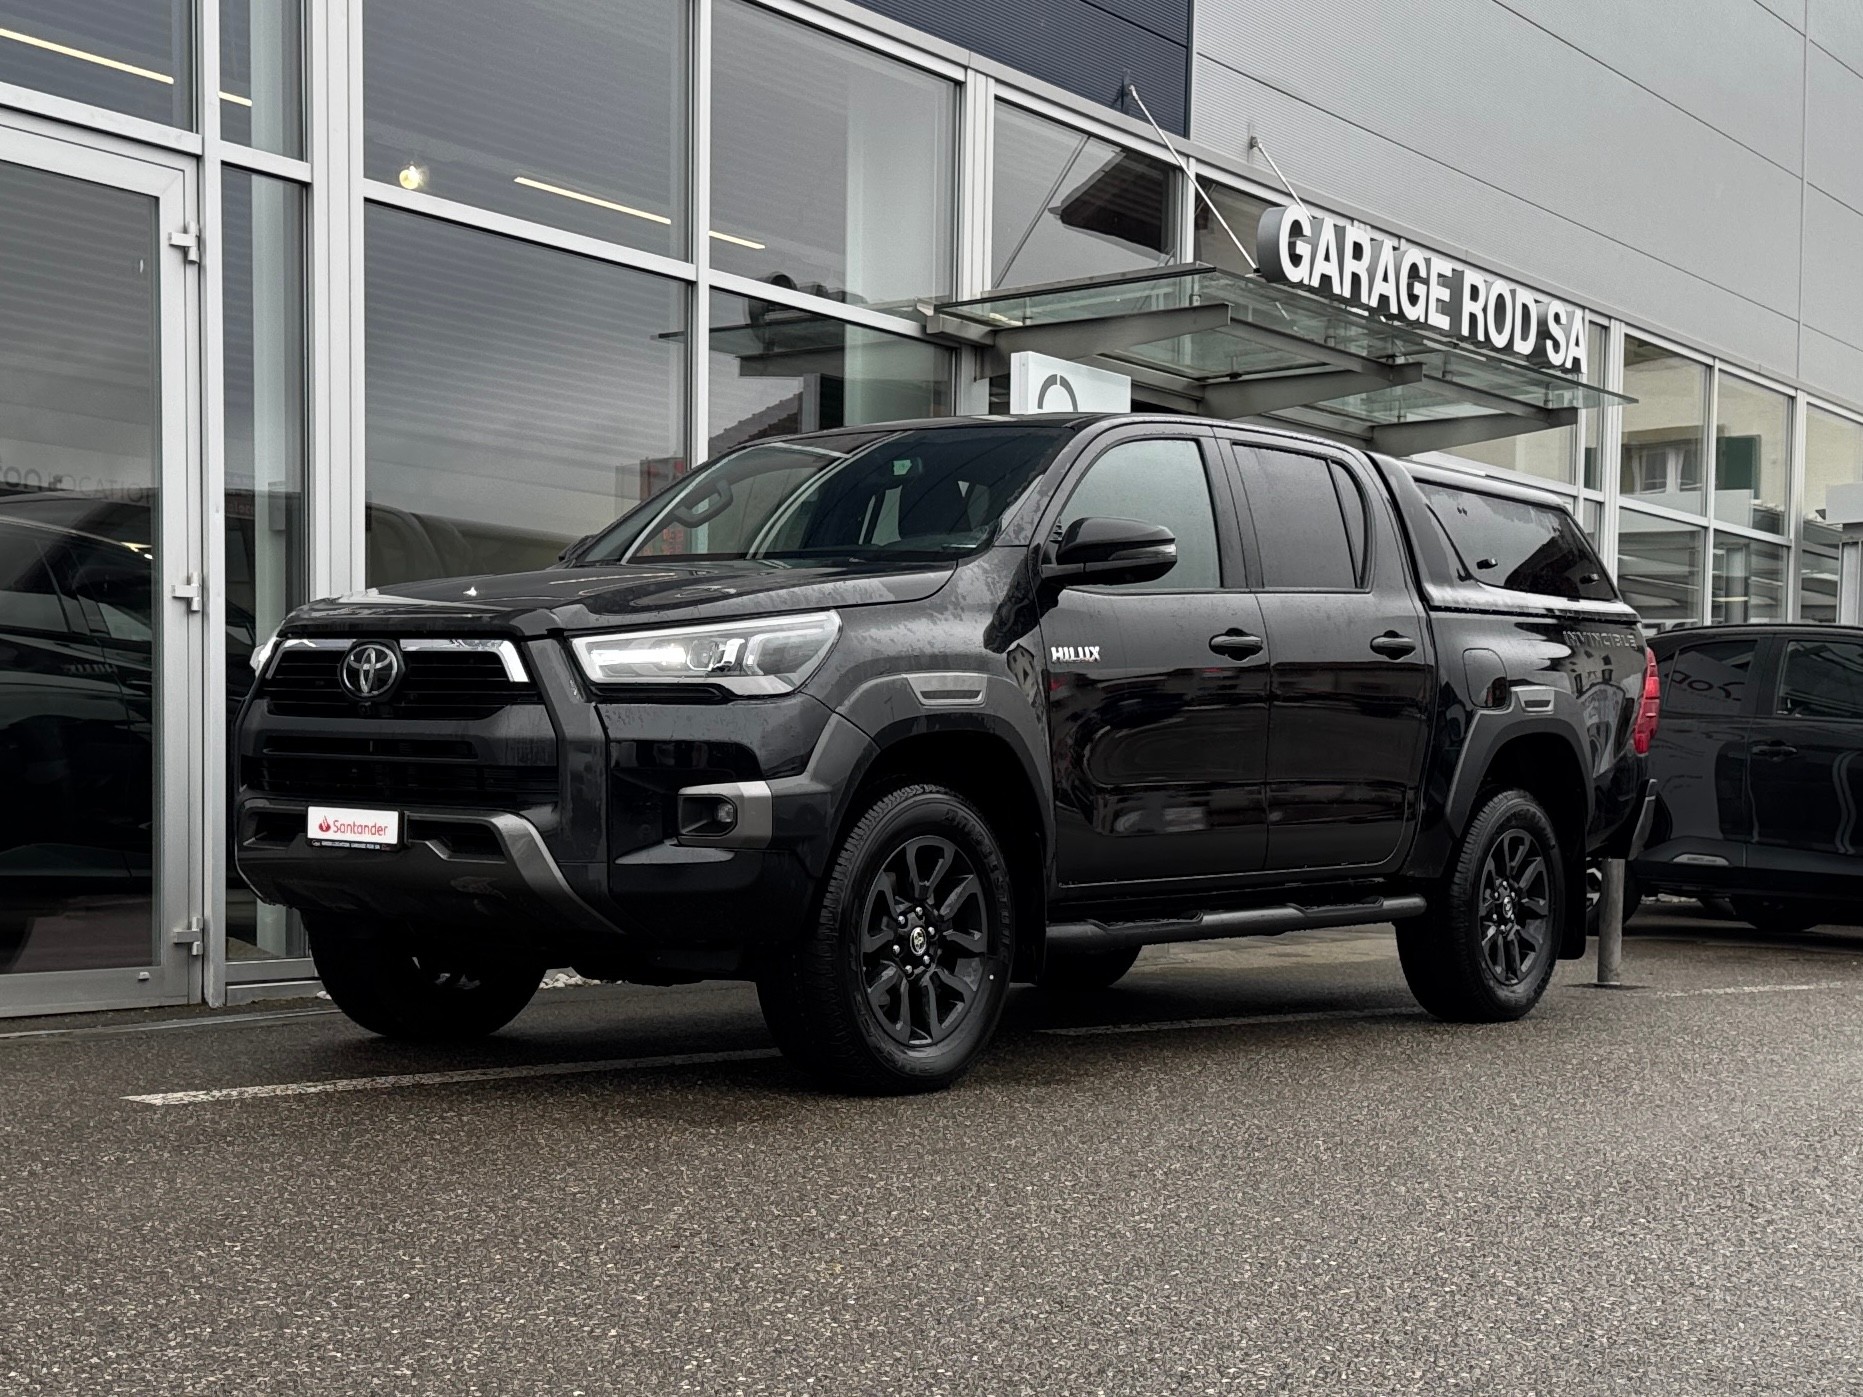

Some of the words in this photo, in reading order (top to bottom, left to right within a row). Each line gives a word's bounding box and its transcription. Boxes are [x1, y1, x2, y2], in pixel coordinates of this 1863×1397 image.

[1275, 205, 1453, 330] GARAGE
[1461, 269, 1537, 355] ROD
[1545, 300, 1588, 374] SA
[1051, 646, 1101, 662] HILUX
[333, 820, 388, 836] Santander
